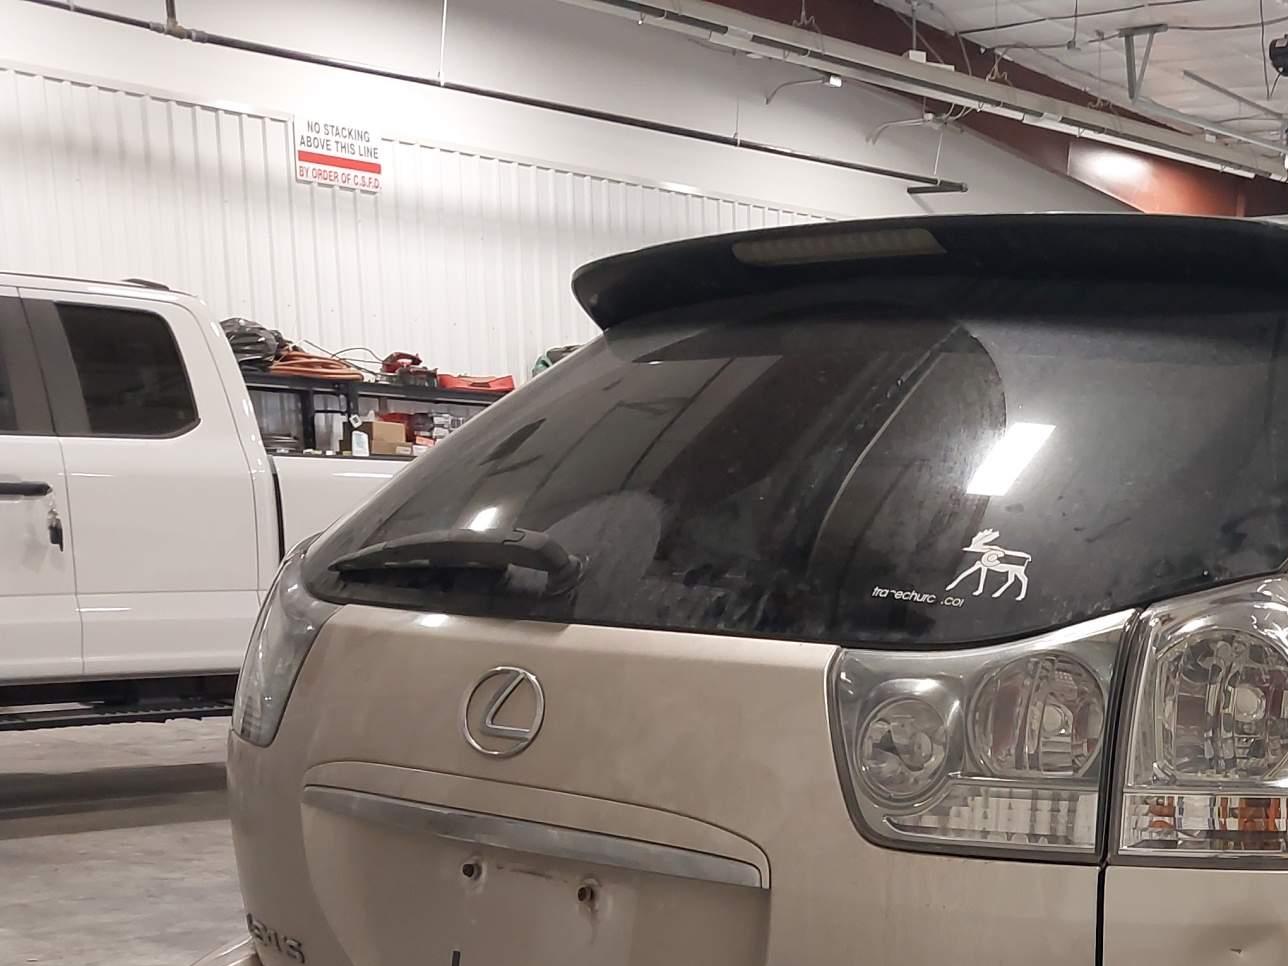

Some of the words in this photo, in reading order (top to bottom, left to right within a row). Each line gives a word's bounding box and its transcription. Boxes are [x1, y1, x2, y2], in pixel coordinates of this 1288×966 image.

[307, 120, 321, 134] NO
[323, 123, 370, 143] STACKING
[299, 135, 332, 151] ABOVE
[334, 140, 356, 156] THIS
[358, 145, 379, 160] LINE
[299, 165, 310, 178] BY
[311, 167, 339, 183] ORDER
[340, 172, 352, 185] OF
